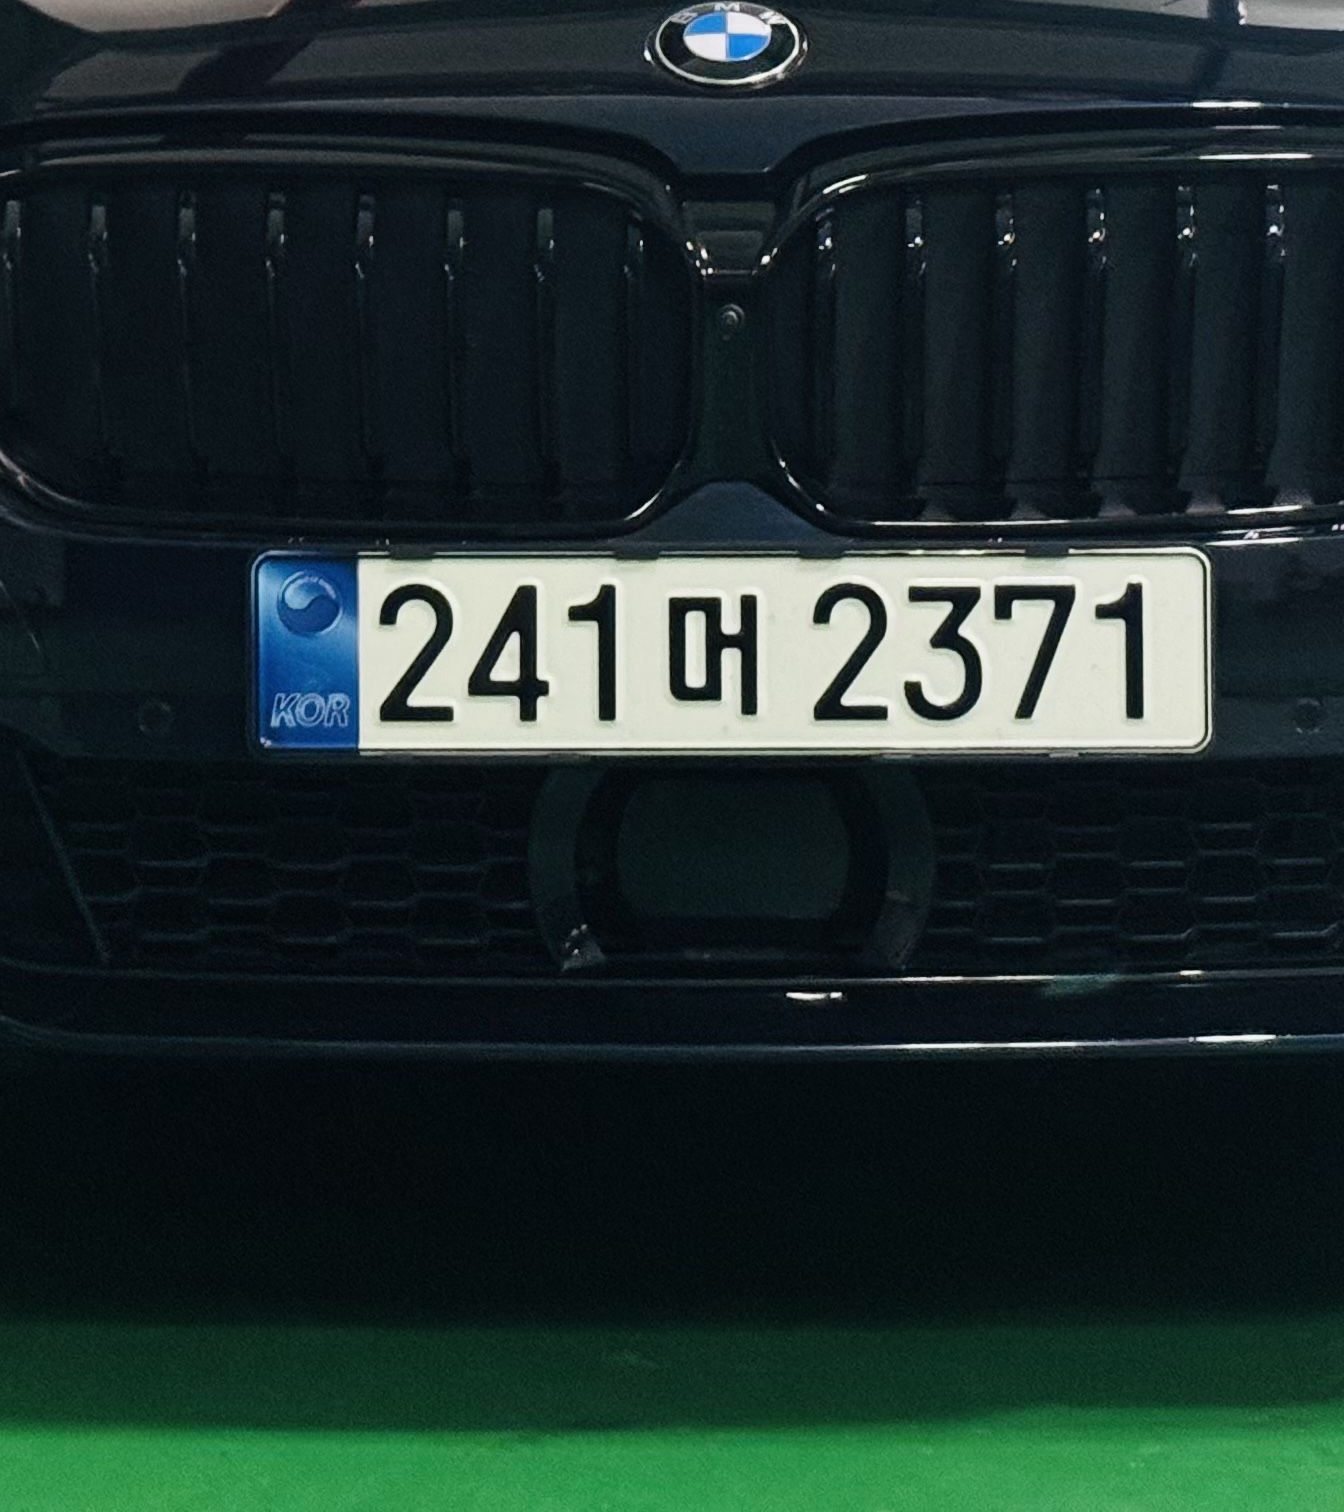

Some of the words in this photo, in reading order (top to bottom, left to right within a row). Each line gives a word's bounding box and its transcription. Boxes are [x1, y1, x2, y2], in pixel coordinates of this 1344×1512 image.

[670, 1, 789, 25] BMW
[811, 581, 1144, 721] 2371
[270, 692, 351, 728] KOR
